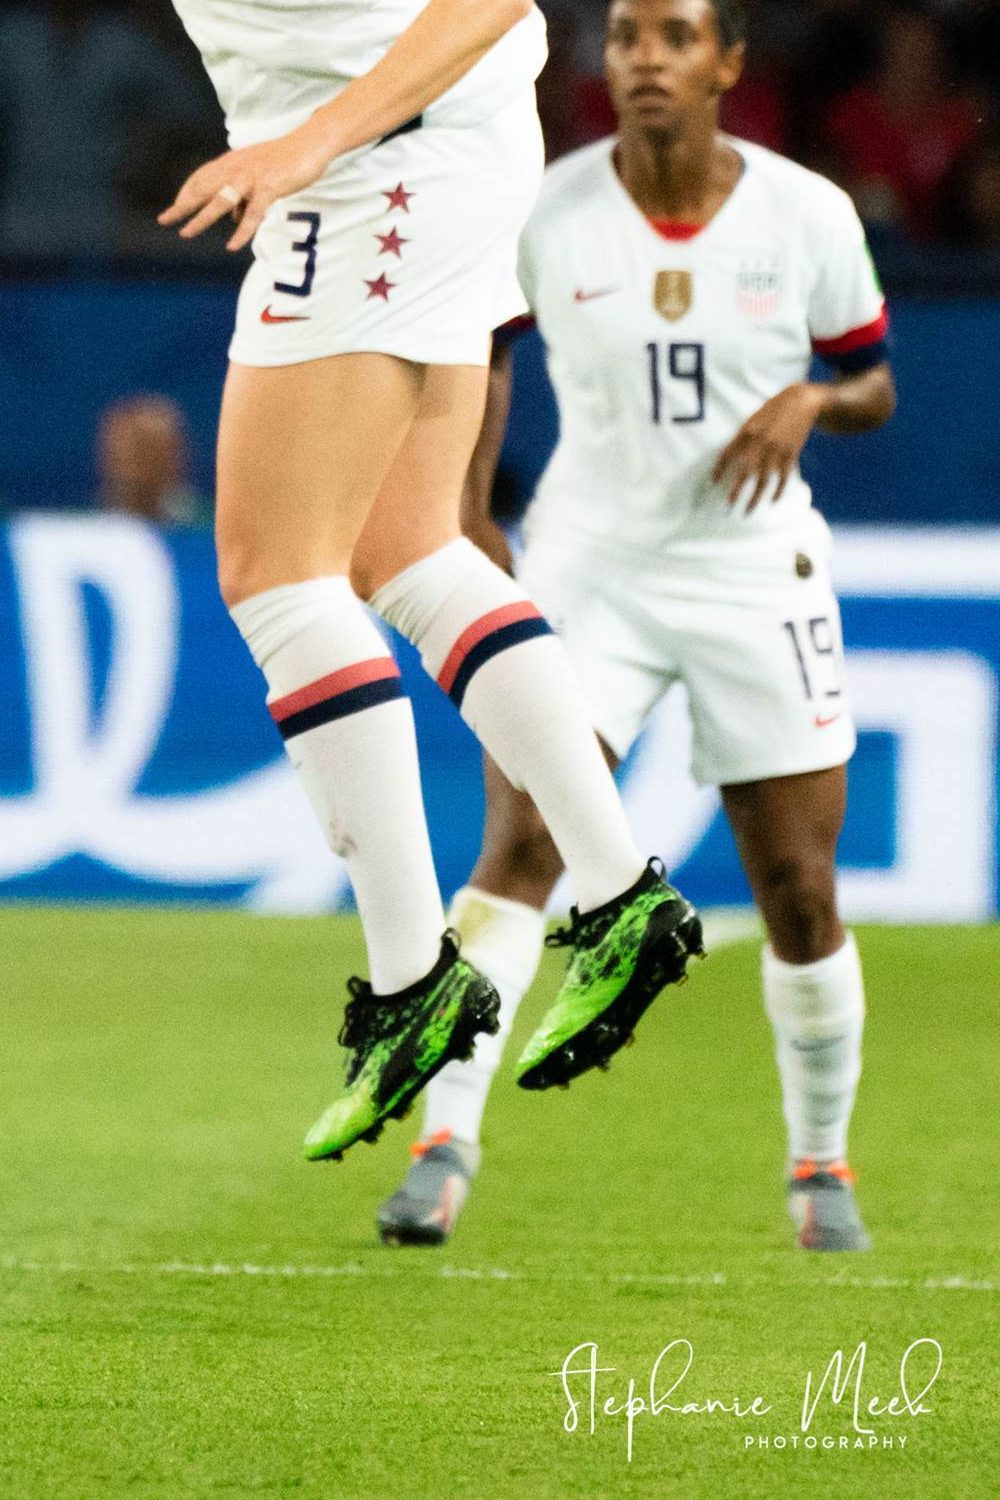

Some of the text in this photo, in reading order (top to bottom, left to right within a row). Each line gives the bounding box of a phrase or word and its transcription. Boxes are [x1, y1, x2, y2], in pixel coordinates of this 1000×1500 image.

[274, 211, 321, 298] 3
[646, 342, 705, 424] 19
[784, 617, 842, 700] 19
